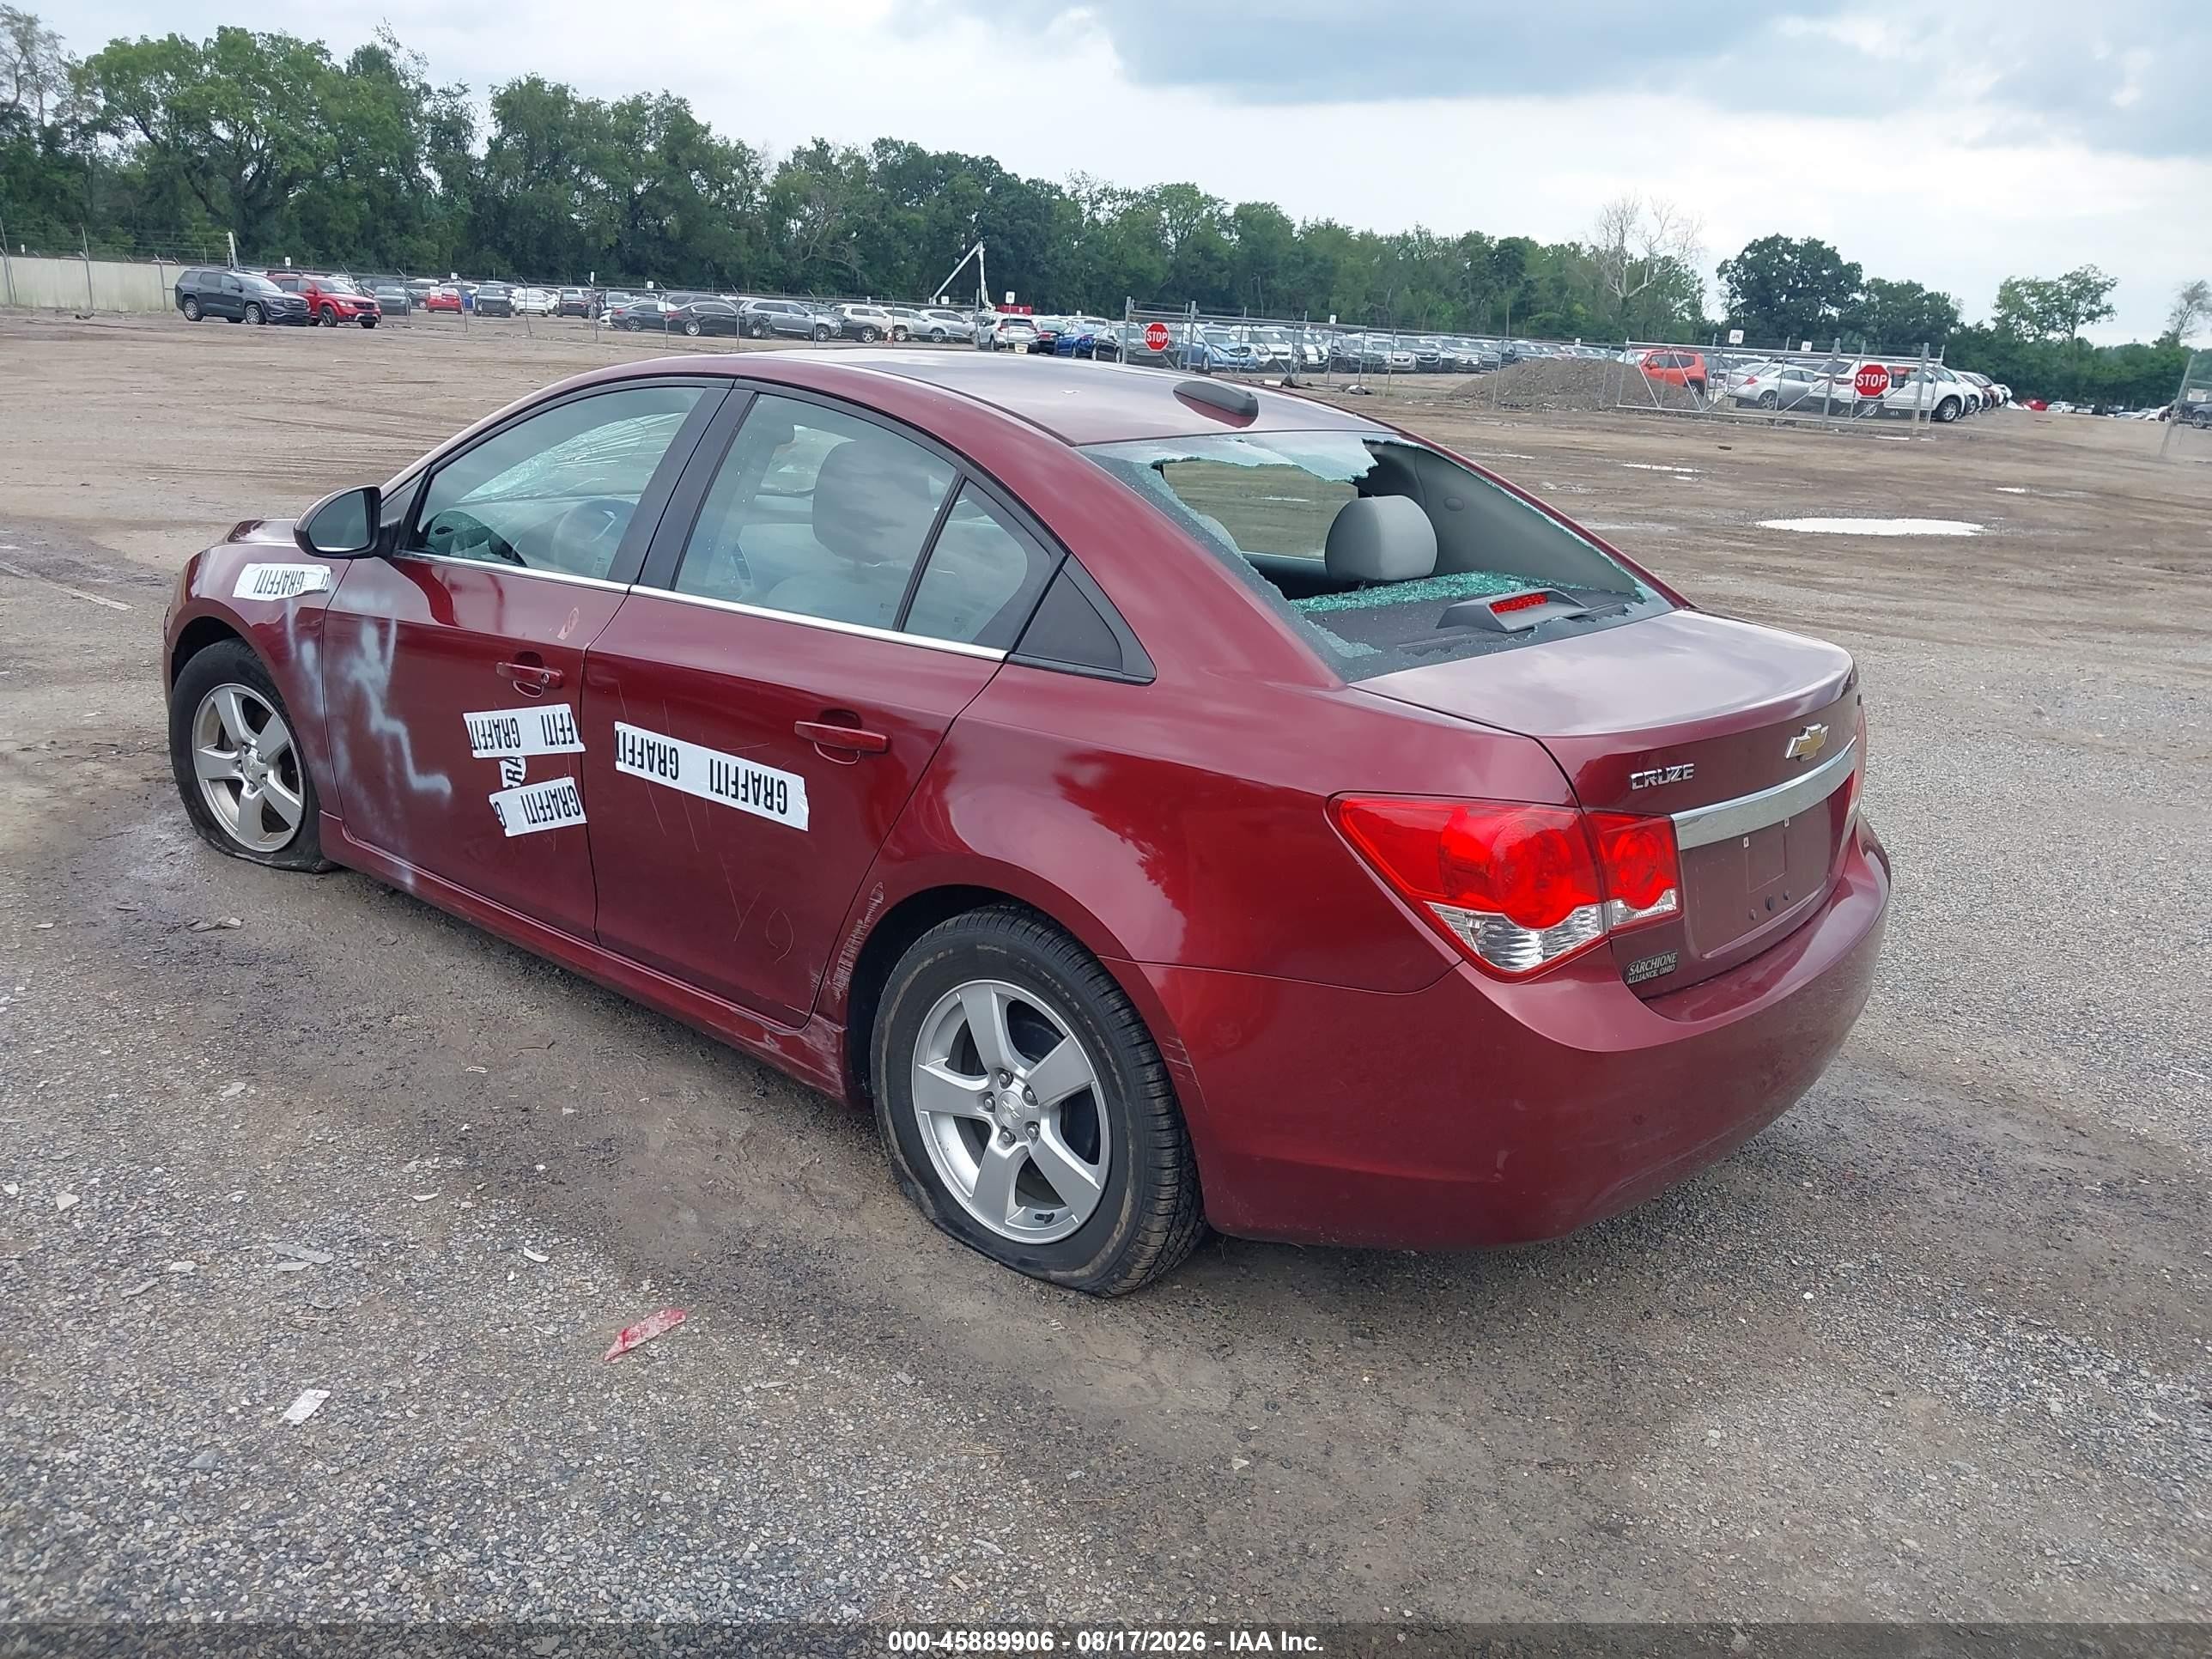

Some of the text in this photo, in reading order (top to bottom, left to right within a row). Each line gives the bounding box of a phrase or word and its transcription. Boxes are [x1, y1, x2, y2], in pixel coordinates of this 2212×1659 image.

[1146, 331, 1168, 343] STOP
[1856, 374, 1887, 387] STOP
[252, 569, 305, 595] GRAFFITI
[708, 758, 788, 816] GRAFFITI
[1631, 763, 1695, 791] CRUZE
[520, 785, 581, 825] GRAFFITI
[1629, 952, 1678, 975] SARCHIONE
[1660, 963, 1675, 975] OHIO
